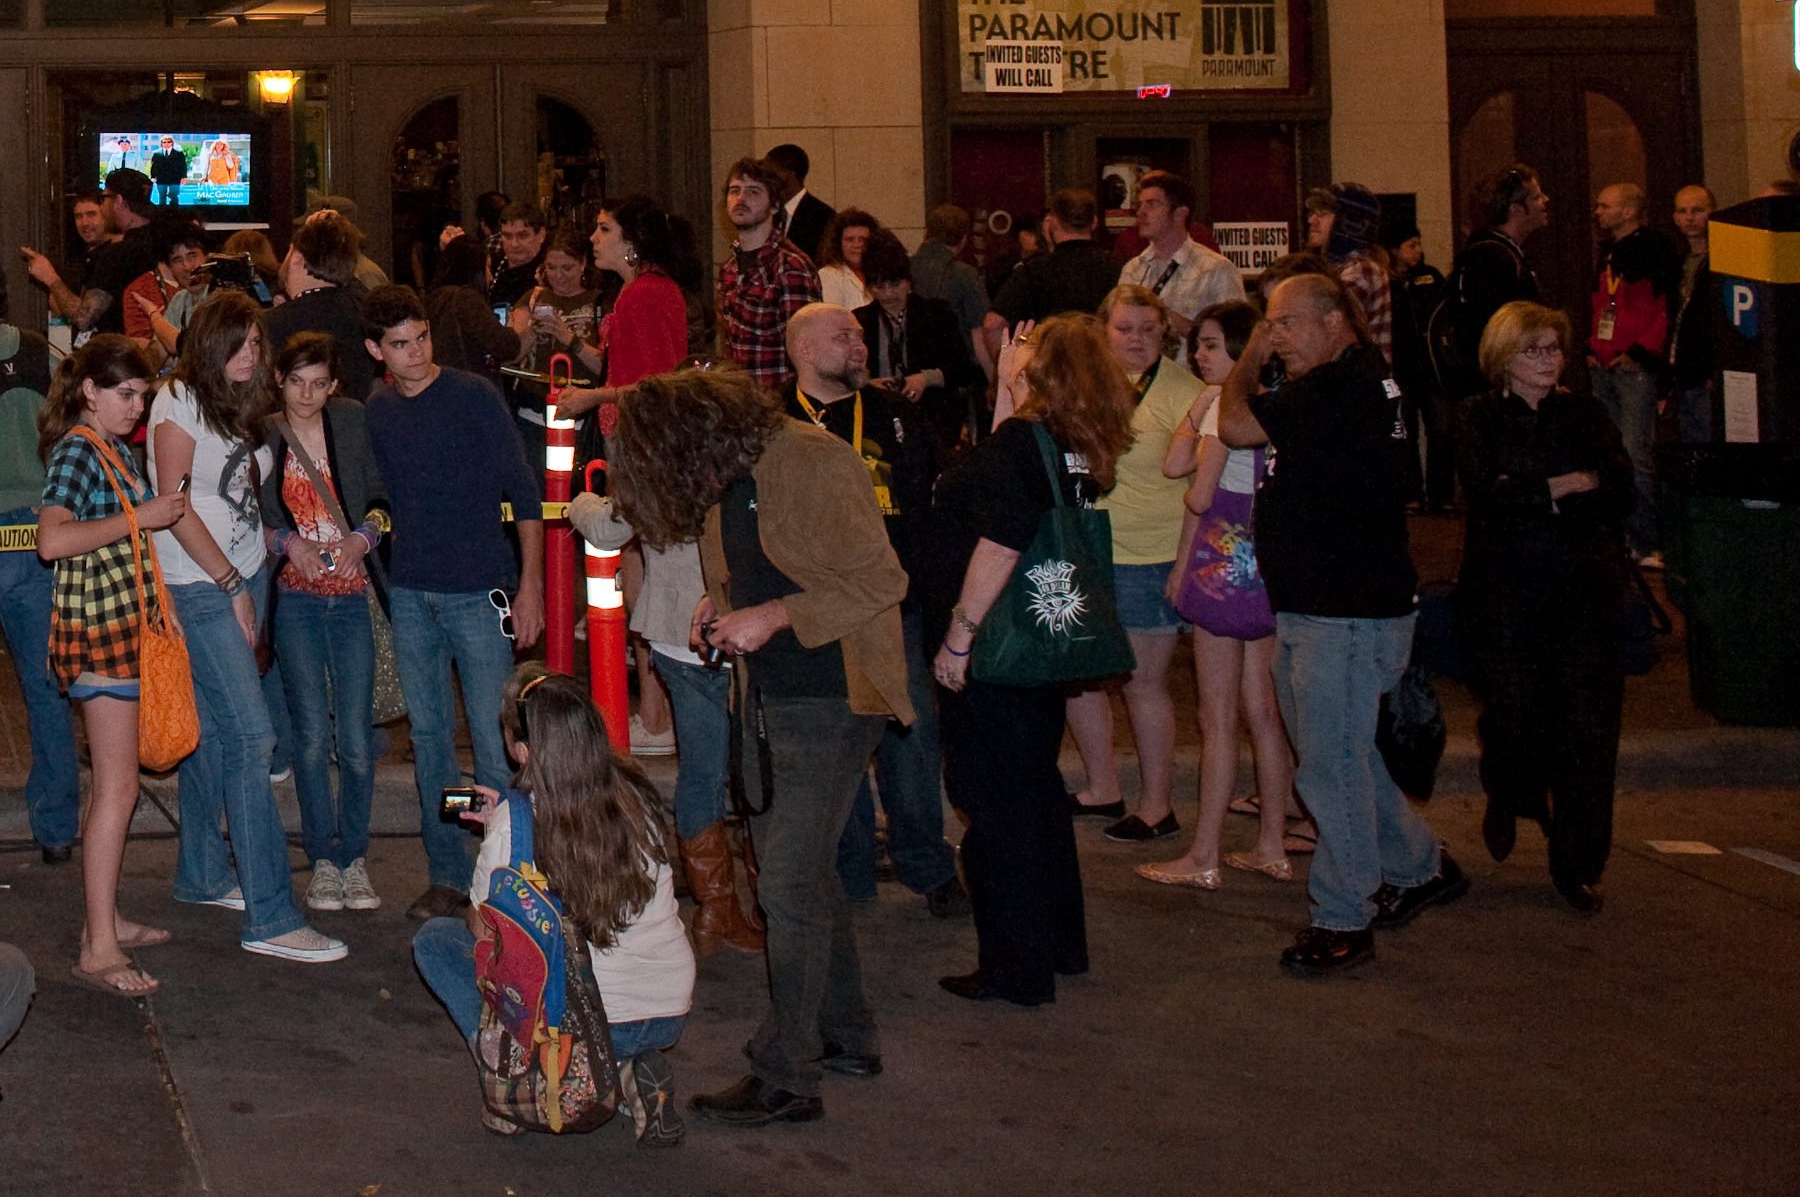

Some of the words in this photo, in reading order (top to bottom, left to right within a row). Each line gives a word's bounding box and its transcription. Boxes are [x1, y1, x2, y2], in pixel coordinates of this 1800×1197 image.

[968, 12, 1182, 42] PARAMOUNT
[986, 45, 1023, 64] INVITED
[1025, 44, 1062, 64] GUESTS
[995, 68, 1023, 88] WILL
[1025, 68, 1053, 88] CALL
[1202, 59, 1276, 77] PARAMOUNT
[1252, 227, 1288, 246] GUESTS
[1733, 285, 1753, 326] P
